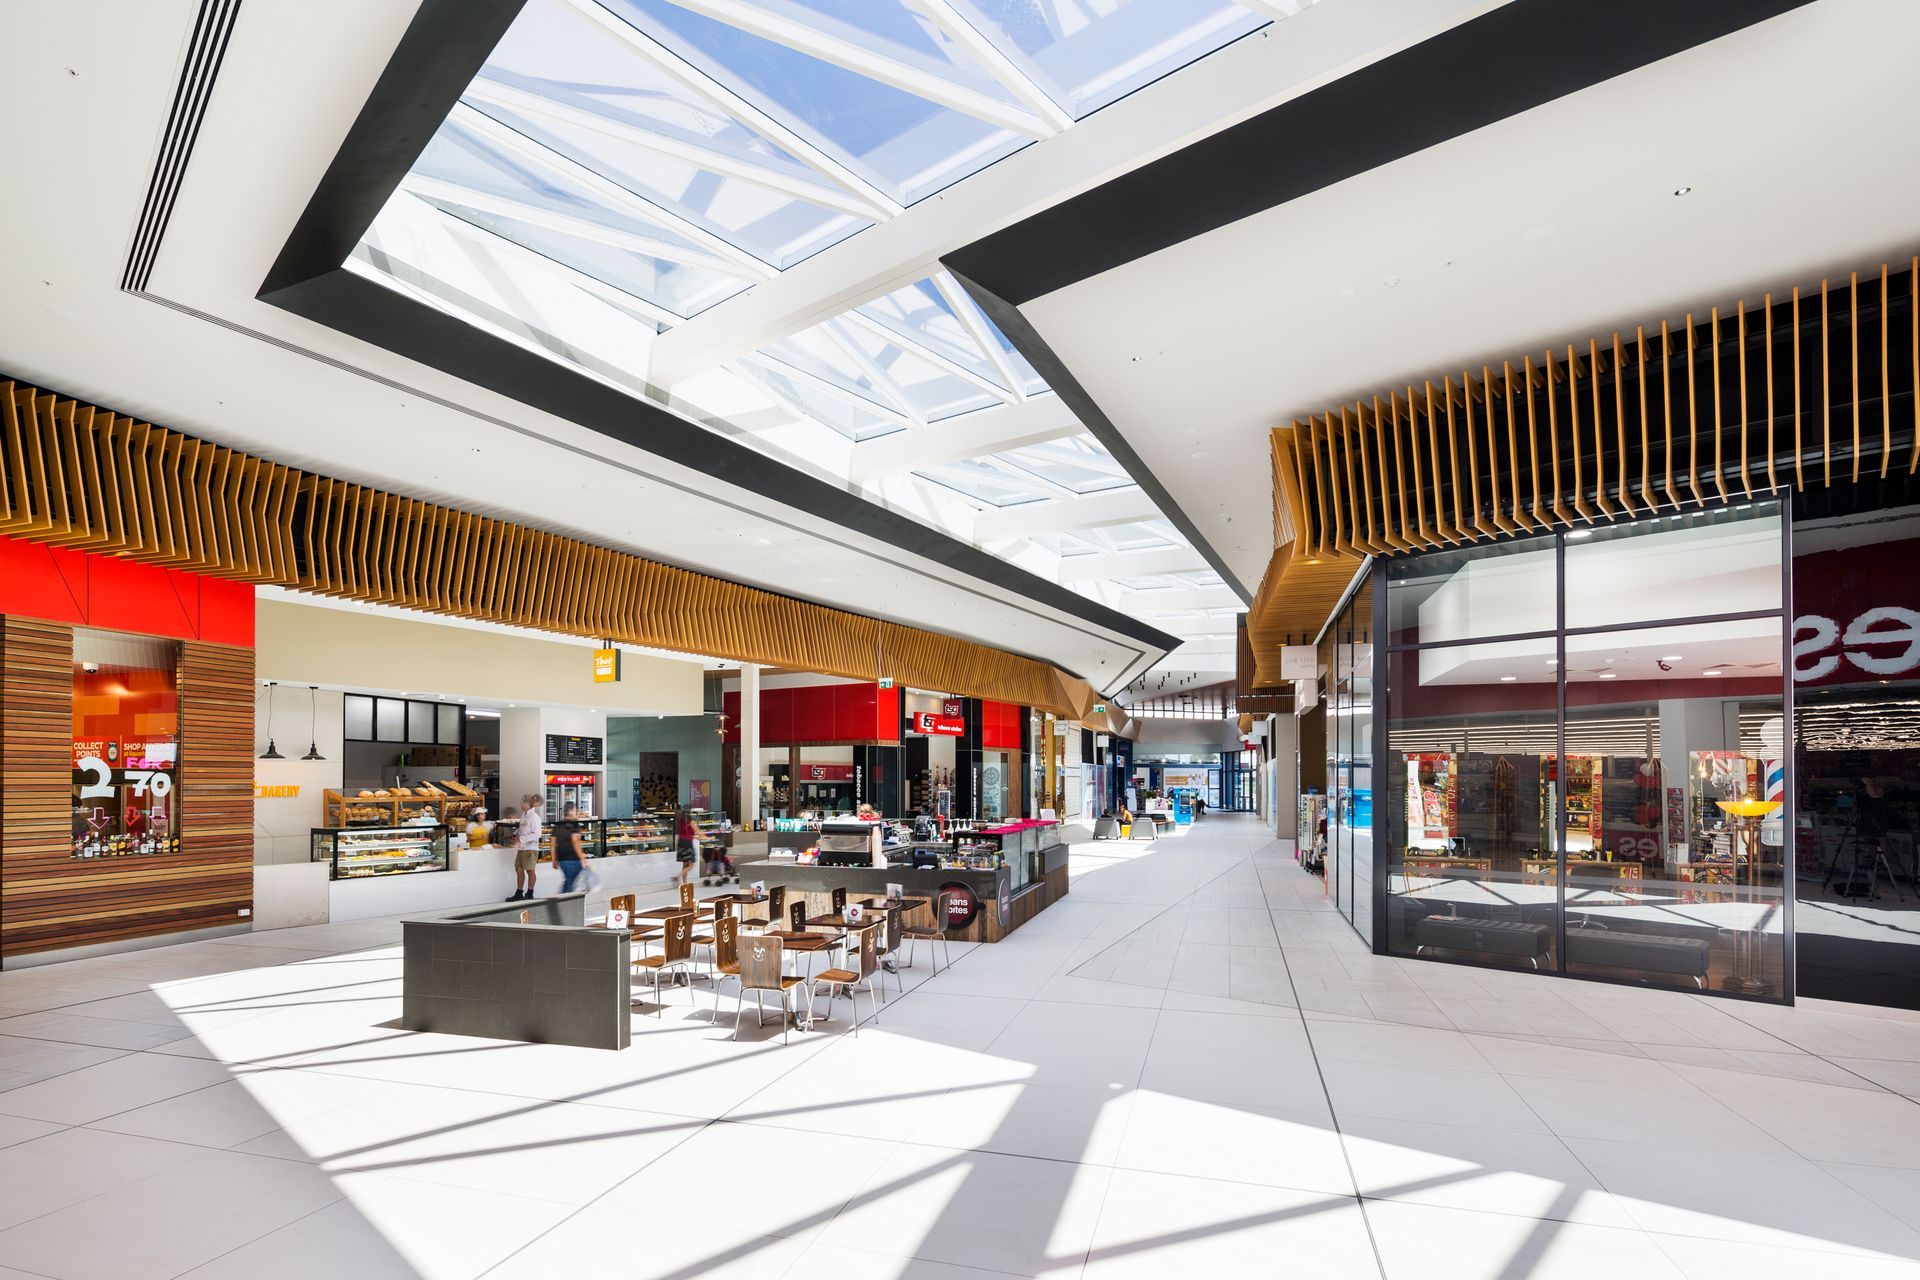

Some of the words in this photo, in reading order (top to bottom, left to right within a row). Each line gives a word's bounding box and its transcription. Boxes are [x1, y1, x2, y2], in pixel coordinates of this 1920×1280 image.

[945, 703, 959, 716] tsg
[73, 742, 104, 750] COLLECT
[123, 743, 141, 751] SHOP
[76, 750, 101, 758] POINTS
[77, 756, 116, 800] 2
[812, 765, 827, 780] tsg
[124, 770, 172, 798] 70
[261, 785, 300, 798] BAKERY
